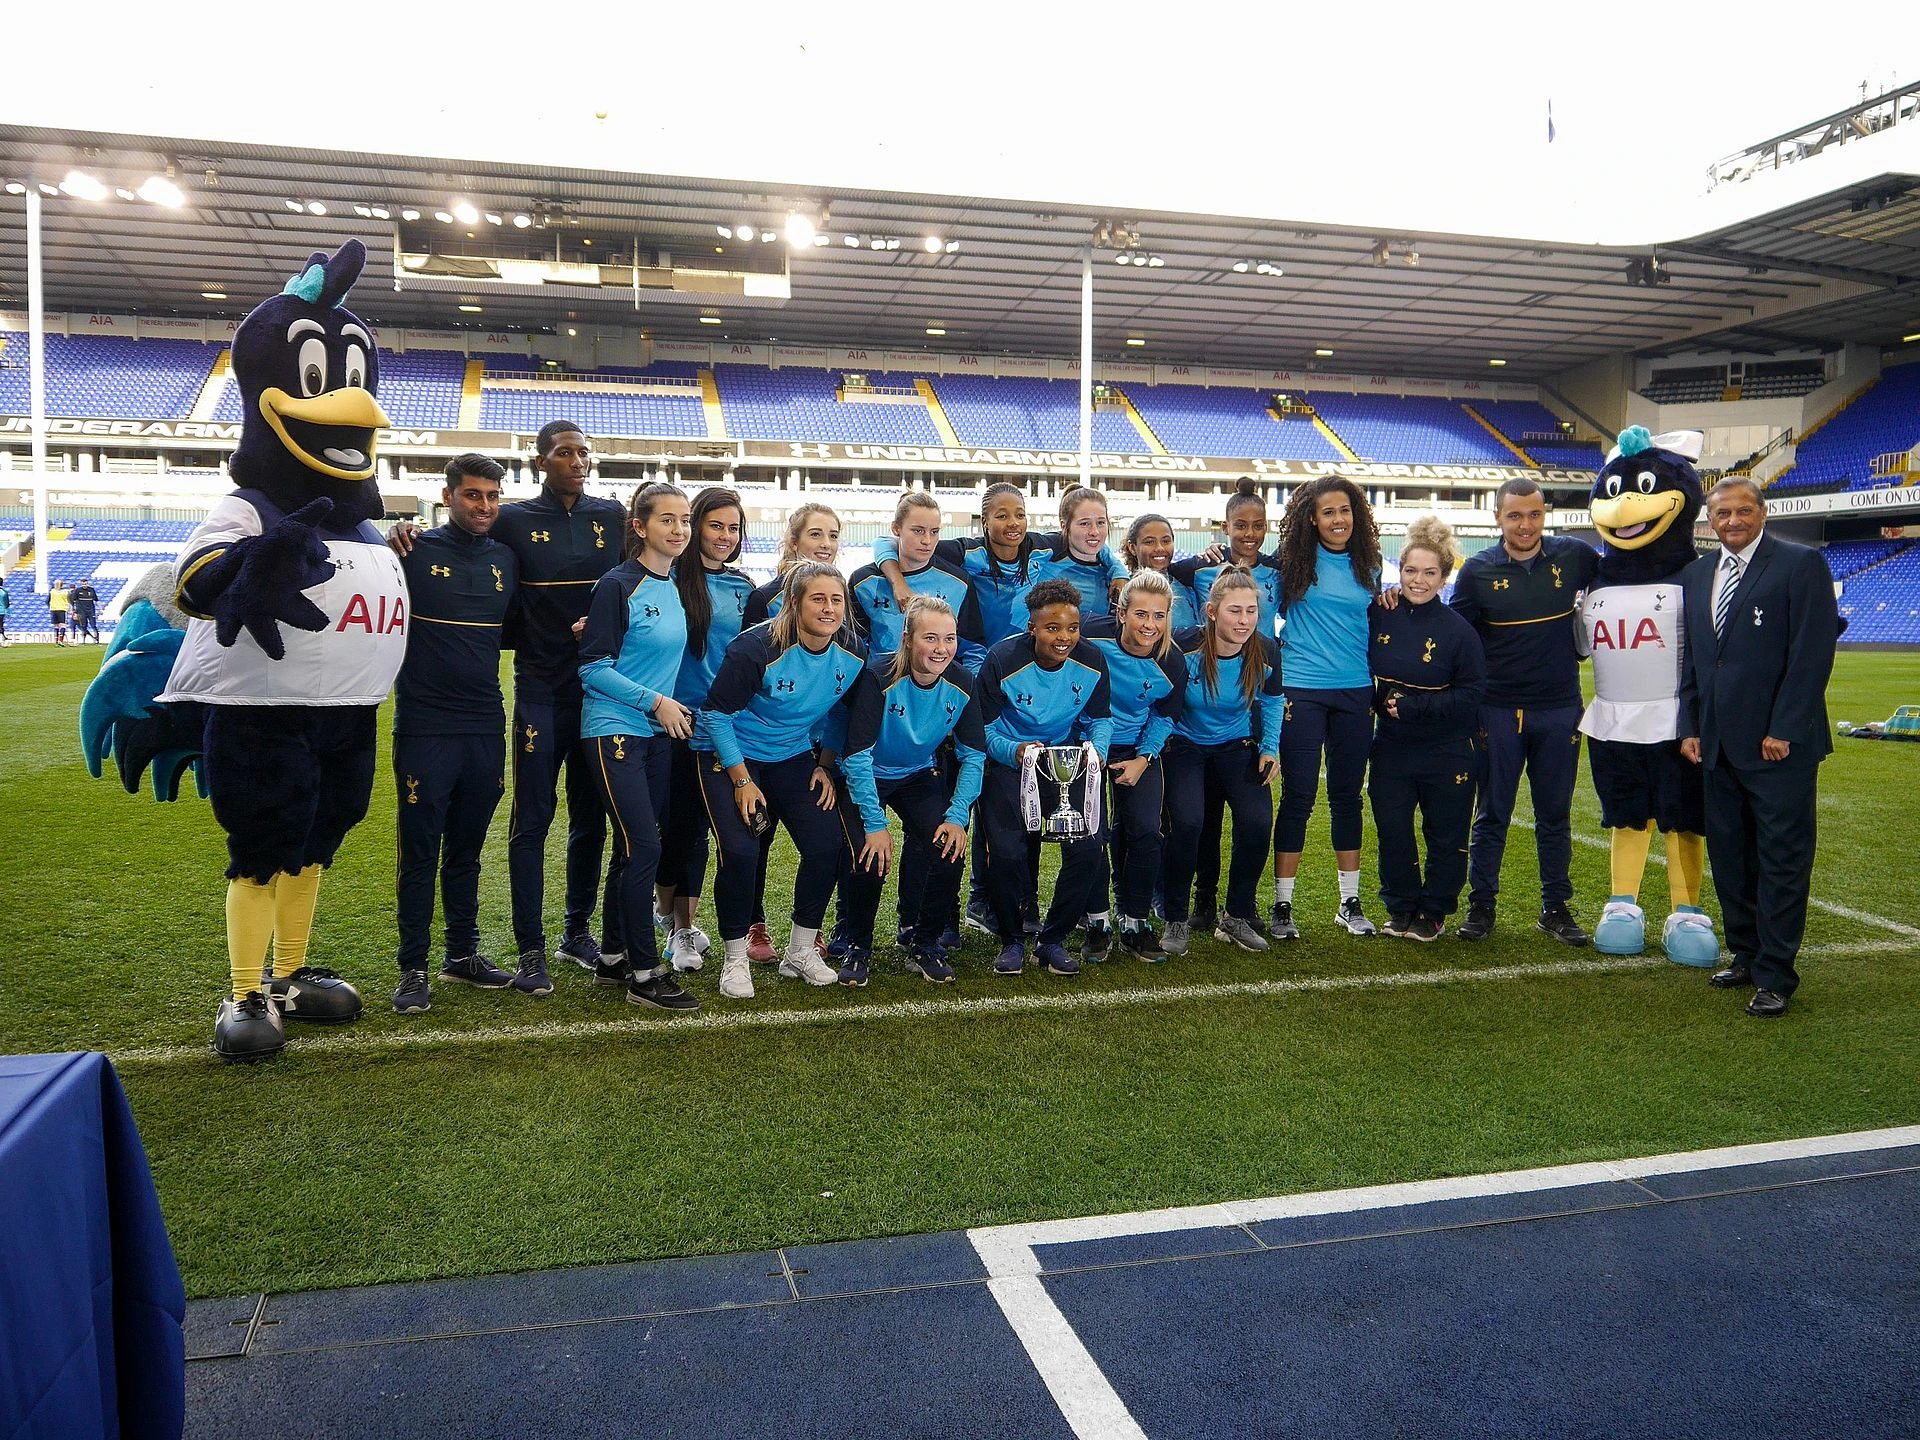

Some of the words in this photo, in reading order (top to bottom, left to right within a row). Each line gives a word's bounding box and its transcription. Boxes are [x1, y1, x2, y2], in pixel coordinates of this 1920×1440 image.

[89, 315, 114, 325] AIA
[226, 321, 240, 331] AI
[486, 334, 509, 344] AIA
[731, 345, 752, 355] AIA
[847, 351, 868, 360] AIA
[958, 356, 979, 366] AIA
[1067, 361, 1081, 370] AI
[1171, 367, 1190, 376] AIA
[1273, 372, 1291, 381] AIA
[1370, 376, 1388, 385] AIA
[1464, 381, 1481, 390] AIA
[1302, 461, 1599, 483] UNDERARMOUR.CO
[1851, 493, 1882, 507] COME
[1885, 490, 1903, 504] ON
[1768, 503, 1777, 514] IS
[1780, 501, 1793, 513] TO
[1796, 499, 1811, 511] DO
[335, 593, 405, 636] AIA
[1592, 617, 1666, 651] AIA
